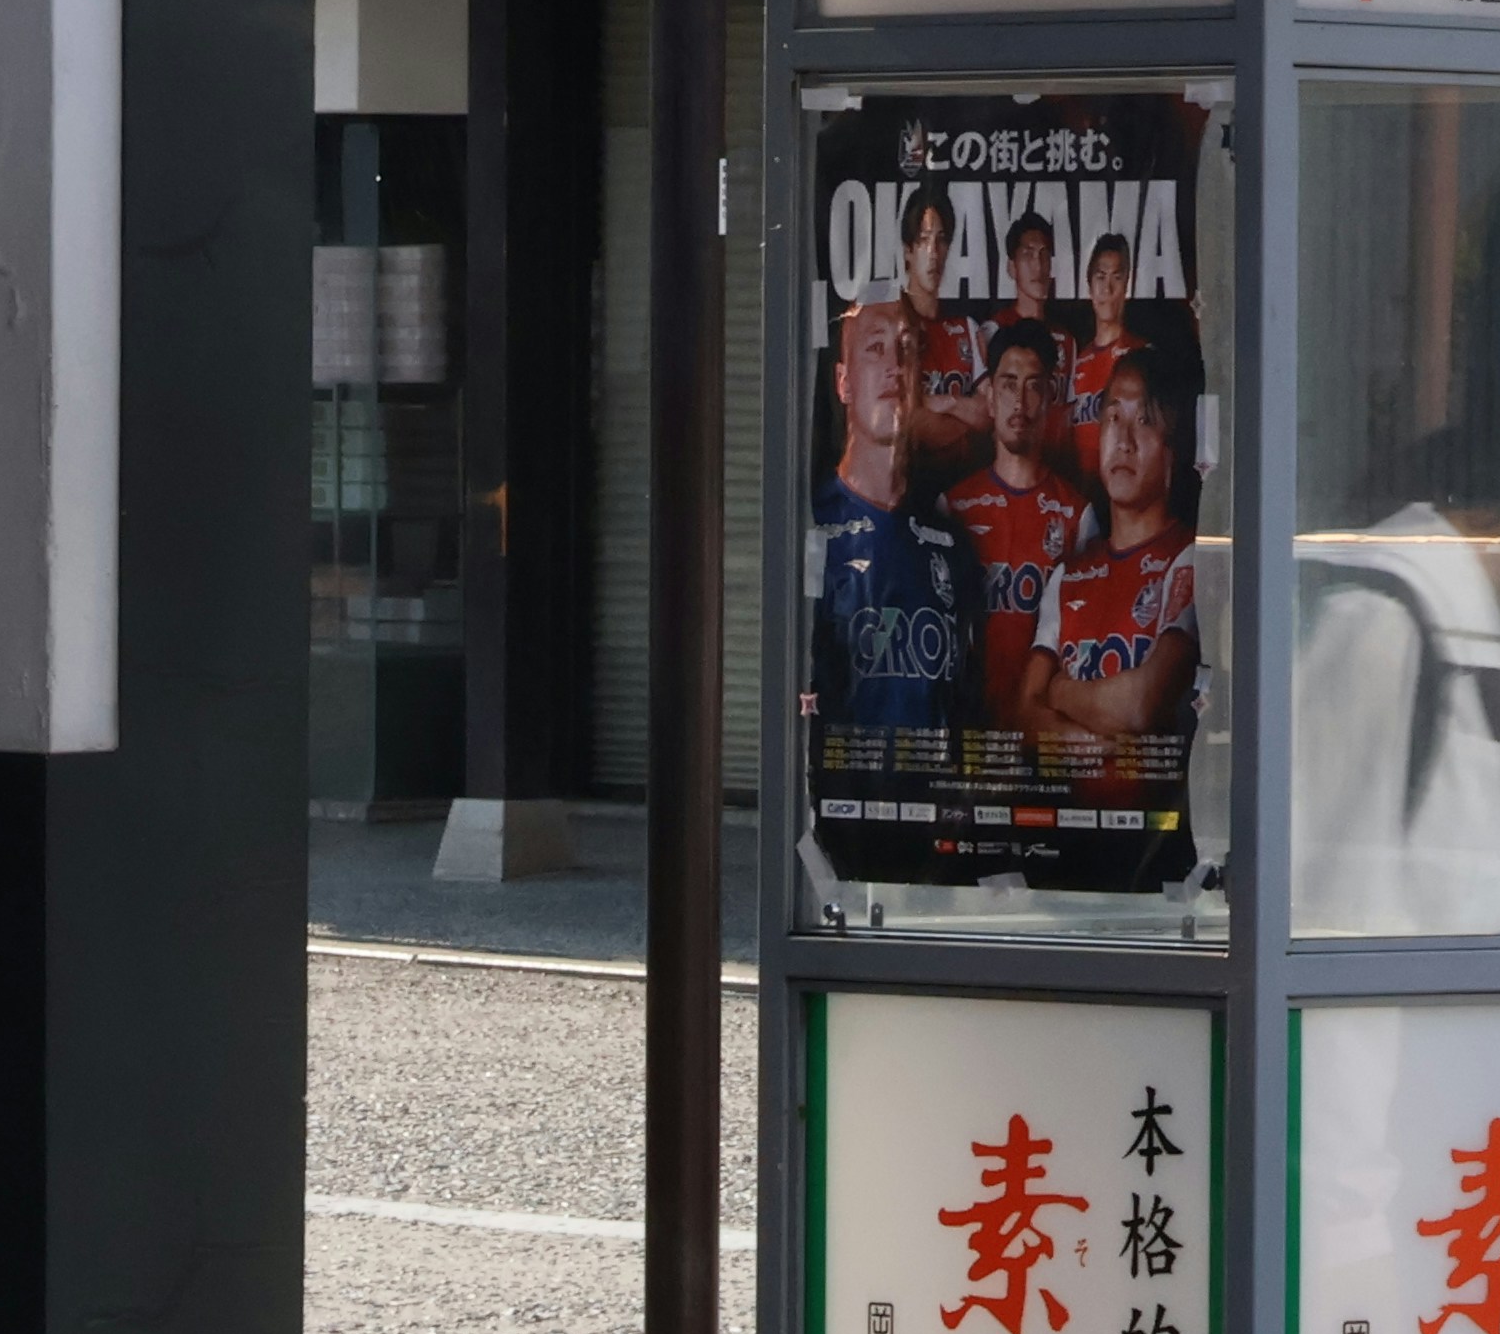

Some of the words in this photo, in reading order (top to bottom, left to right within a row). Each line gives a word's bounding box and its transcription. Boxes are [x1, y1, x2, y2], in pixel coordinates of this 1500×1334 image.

[926, 128, 1124, 173] この街と挑む。
